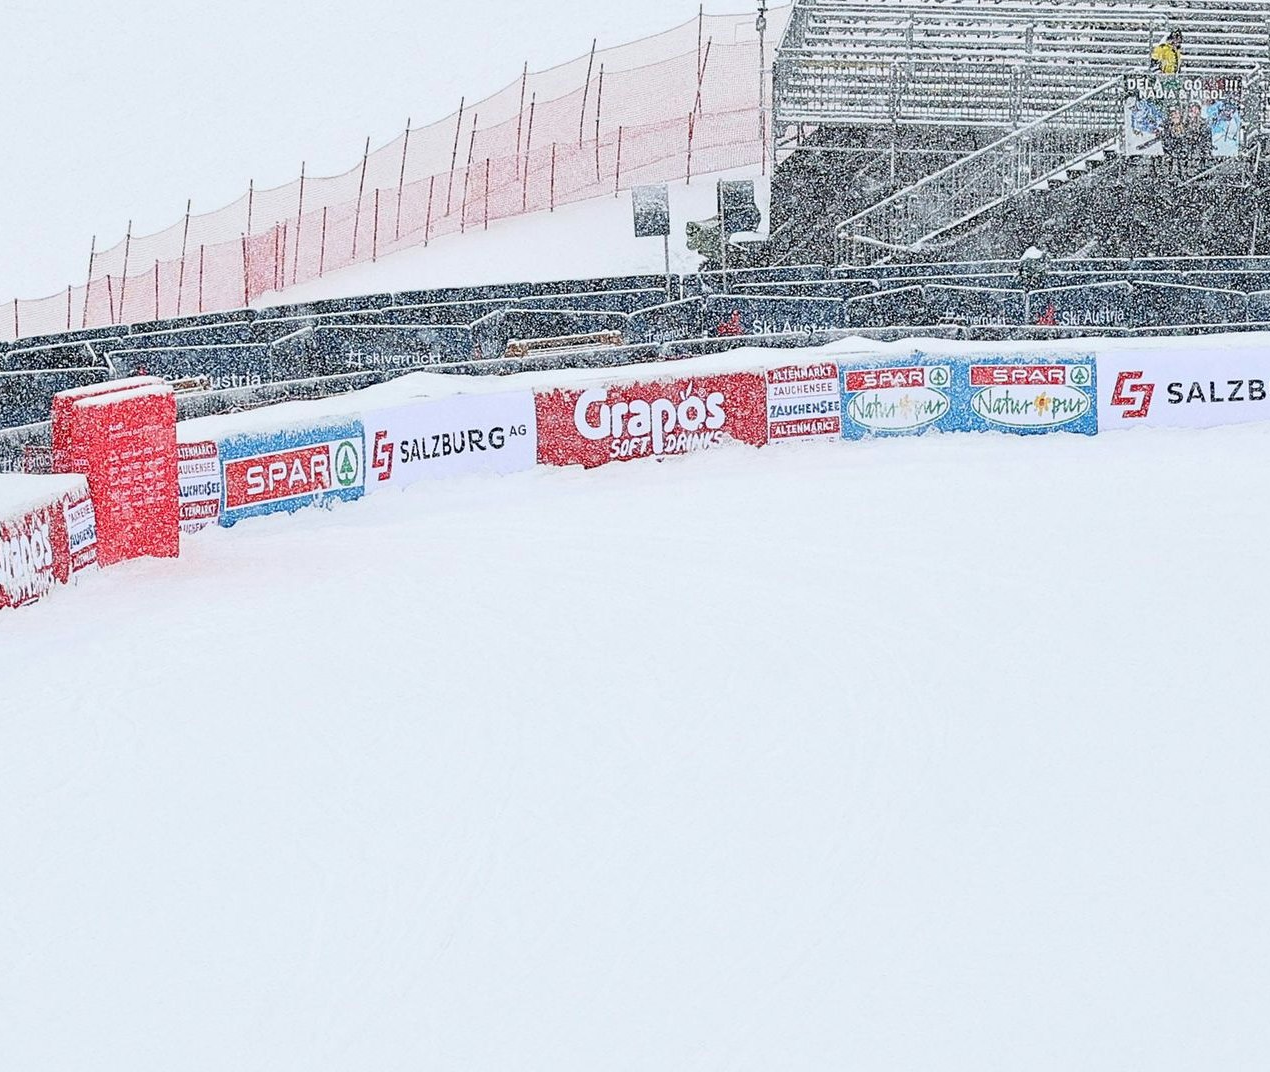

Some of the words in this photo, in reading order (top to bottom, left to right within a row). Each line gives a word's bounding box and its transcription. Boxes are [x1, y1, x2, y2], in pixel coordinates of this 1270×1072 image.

[1179, 89, 1187, 99] &
[1062, 310, 1080, 326] Ski
[1084, 306, 1125, 324] Austria
[773, 365, 833, 381] ALTENMARKT
[864, 370, 923, 387] SPAR
[993, 369, 1065, 383] SPAR
[774, 382, 833, 396] ZAUCHENSEE
[770, 400, 840, 418] ZAUCHENSEE
[977, 387, 1033, 416] Natur
[1051, 398, 1086, 416] pur
[774, 421, 835, 436] ALTENMARKT
[179, 444, 217, 458] LTENMARKT
[400, 425, 506, 465] SALZBURG
[509, 422, 528, 438] AG
[609, 434, 648, 458] SOFT
[662, 429, 724, 453] DRINKS
[179, 460, 217, 475] AUCHENSEE
[245, 456, 330, 495] SPAR
[179, 480, 221, 498] AUCHENSEE
[179, 503, 218, 520] LTENMARKT
